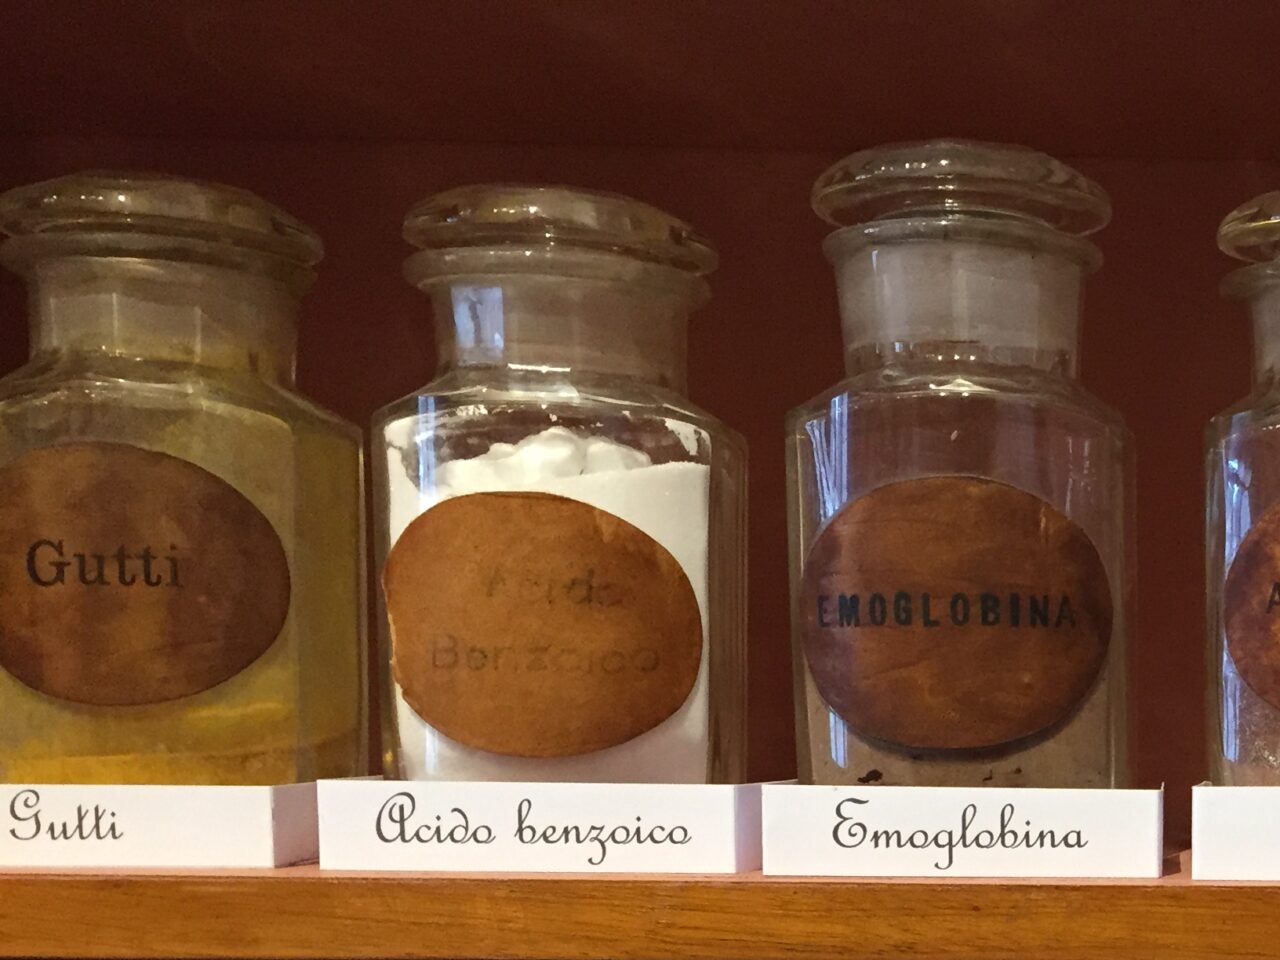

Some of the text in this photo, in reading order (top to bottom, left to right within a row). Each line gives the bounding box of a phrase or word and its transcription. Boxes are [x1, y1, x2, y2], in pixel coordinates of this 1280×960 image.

[26, 538, 184, 588] Gutti
[816, 591, 1077, 628] EMOGLOBINA
[8, 788, 124, 841] Gutti
[375, 791, 693, 866] Acido benzoico
[831, 797, 1089, 871] Emoglobina
